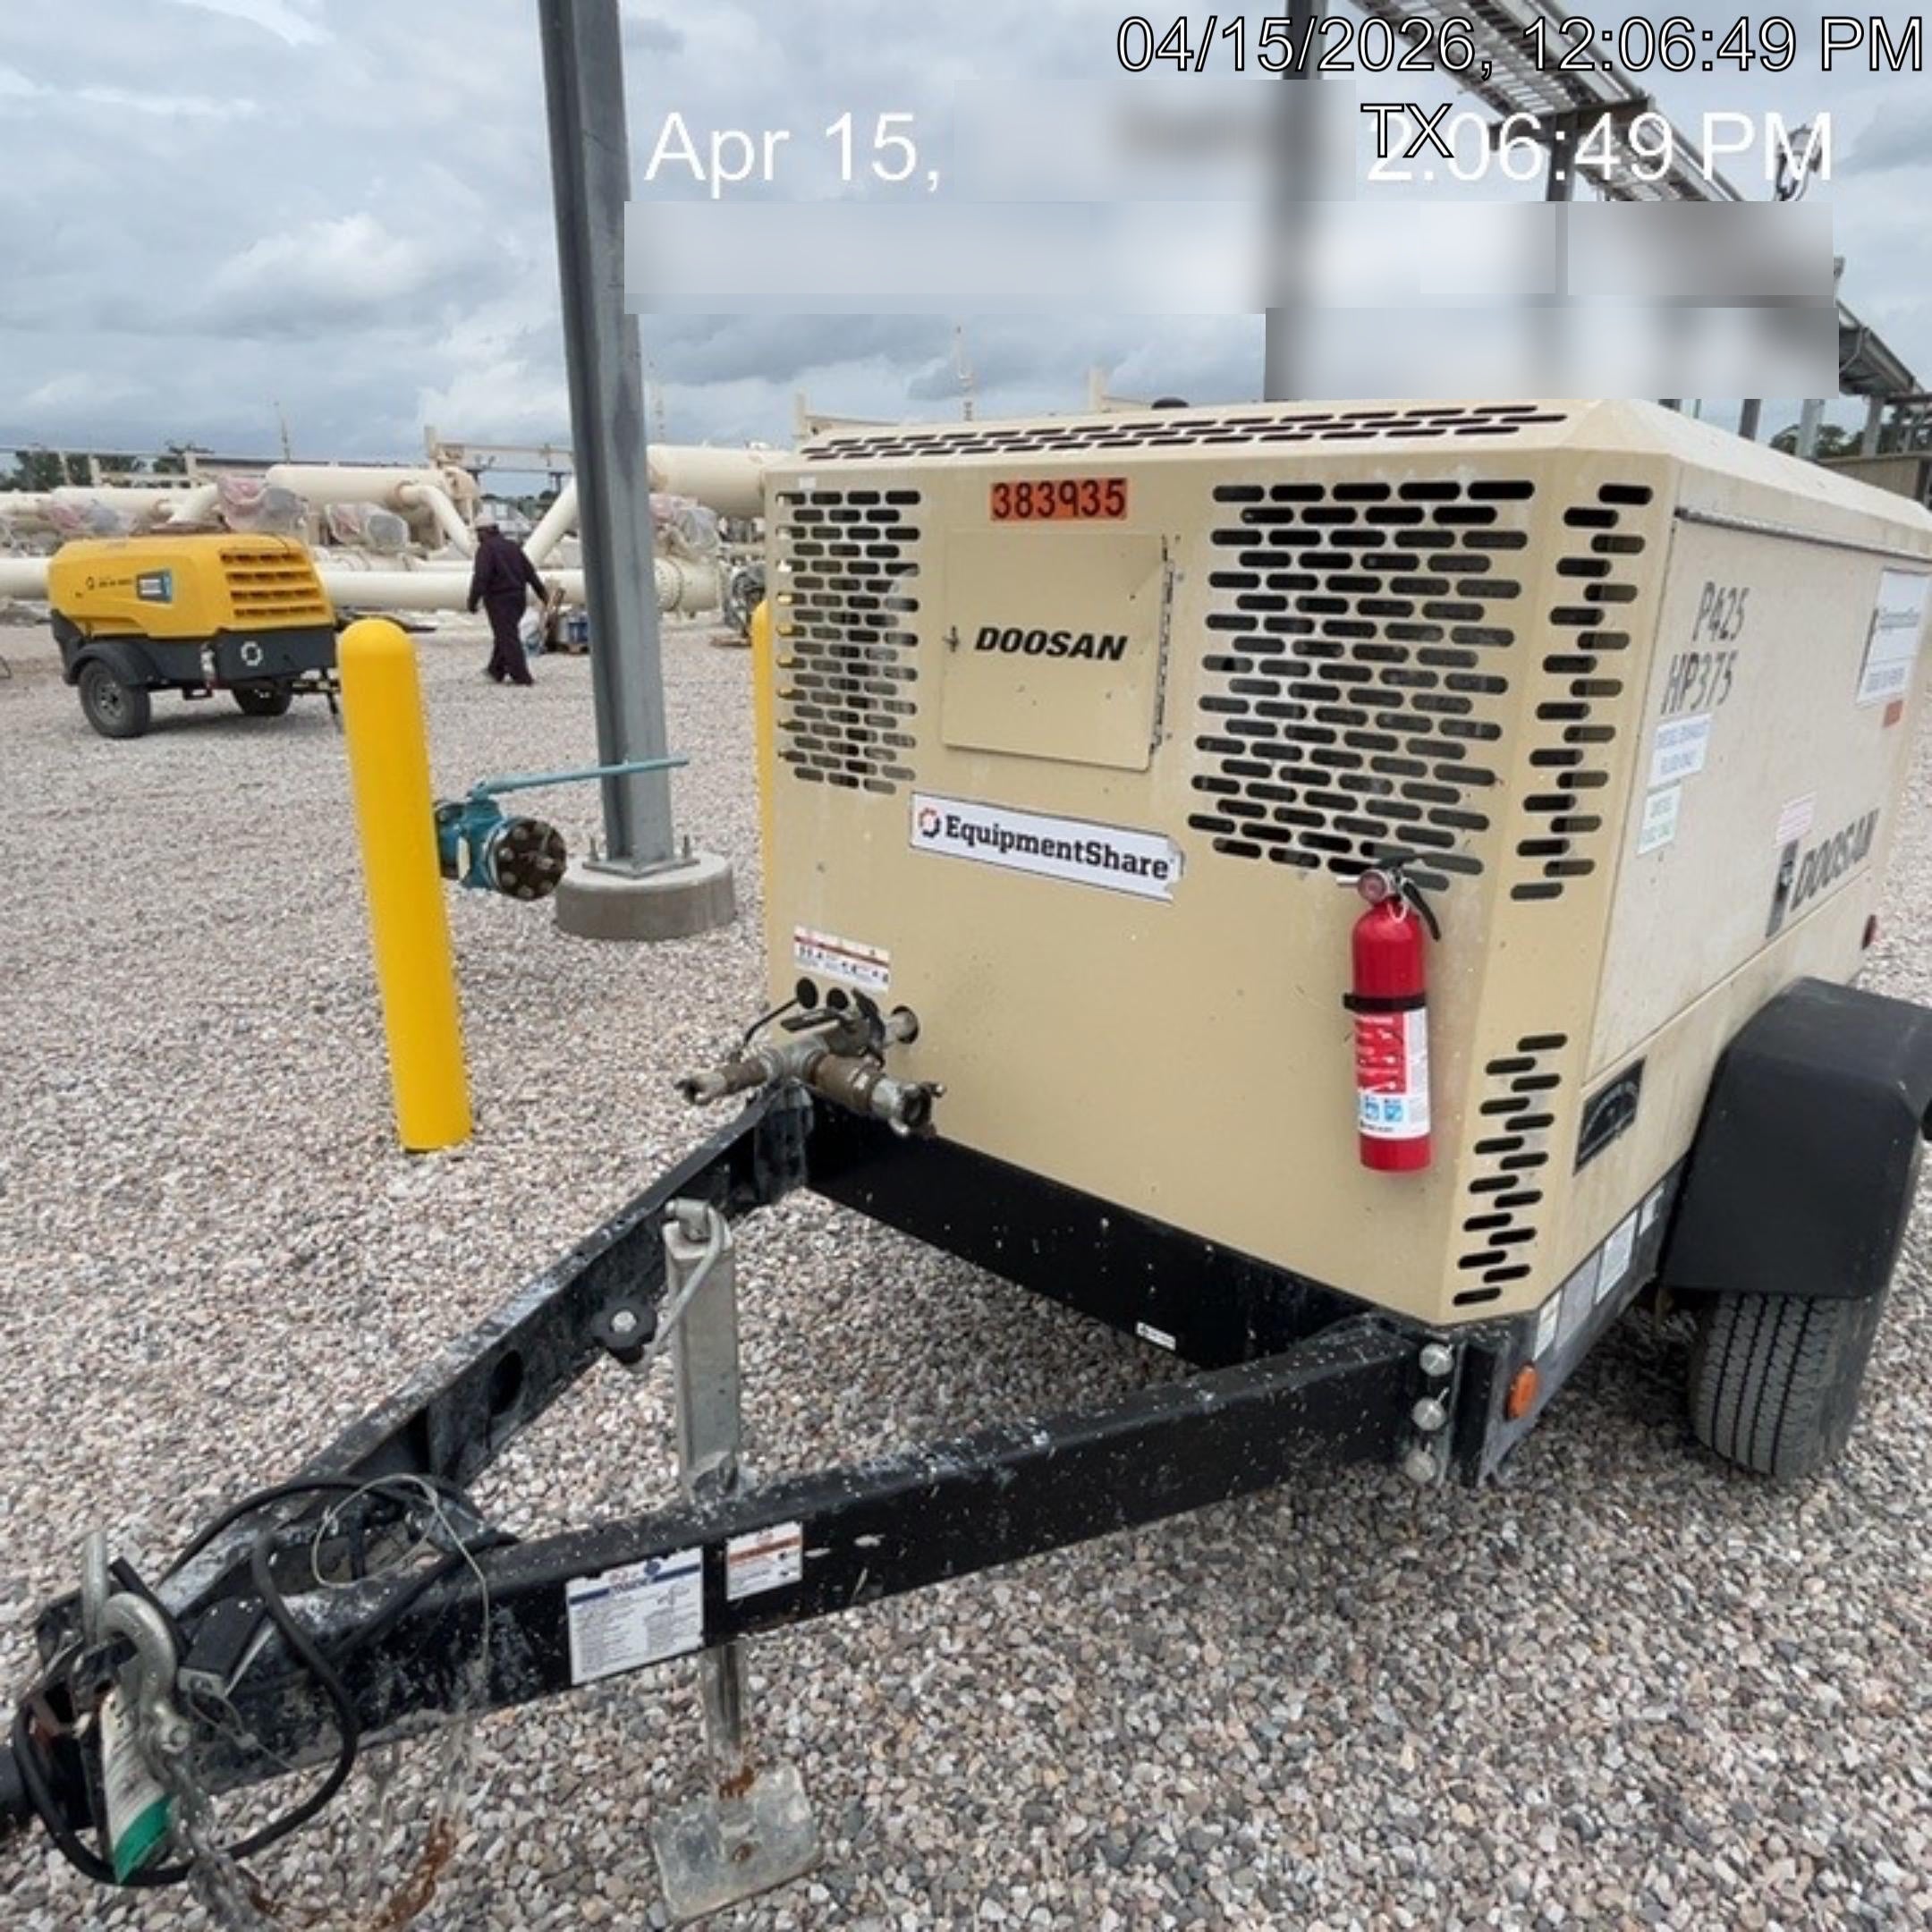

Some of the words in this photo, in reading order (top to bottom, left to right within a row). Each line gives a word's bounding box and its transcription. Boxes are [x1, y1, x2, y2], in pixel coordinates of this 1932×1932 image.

[992, 478, 1127, 519] 383935
[1692, 581, 1750, 642] P425
[974, 627, 1128, 661] DOOSAN
[1660, 649, 1739, 715] HP375
[945, 814, 1170, 881] EquipmentShare
